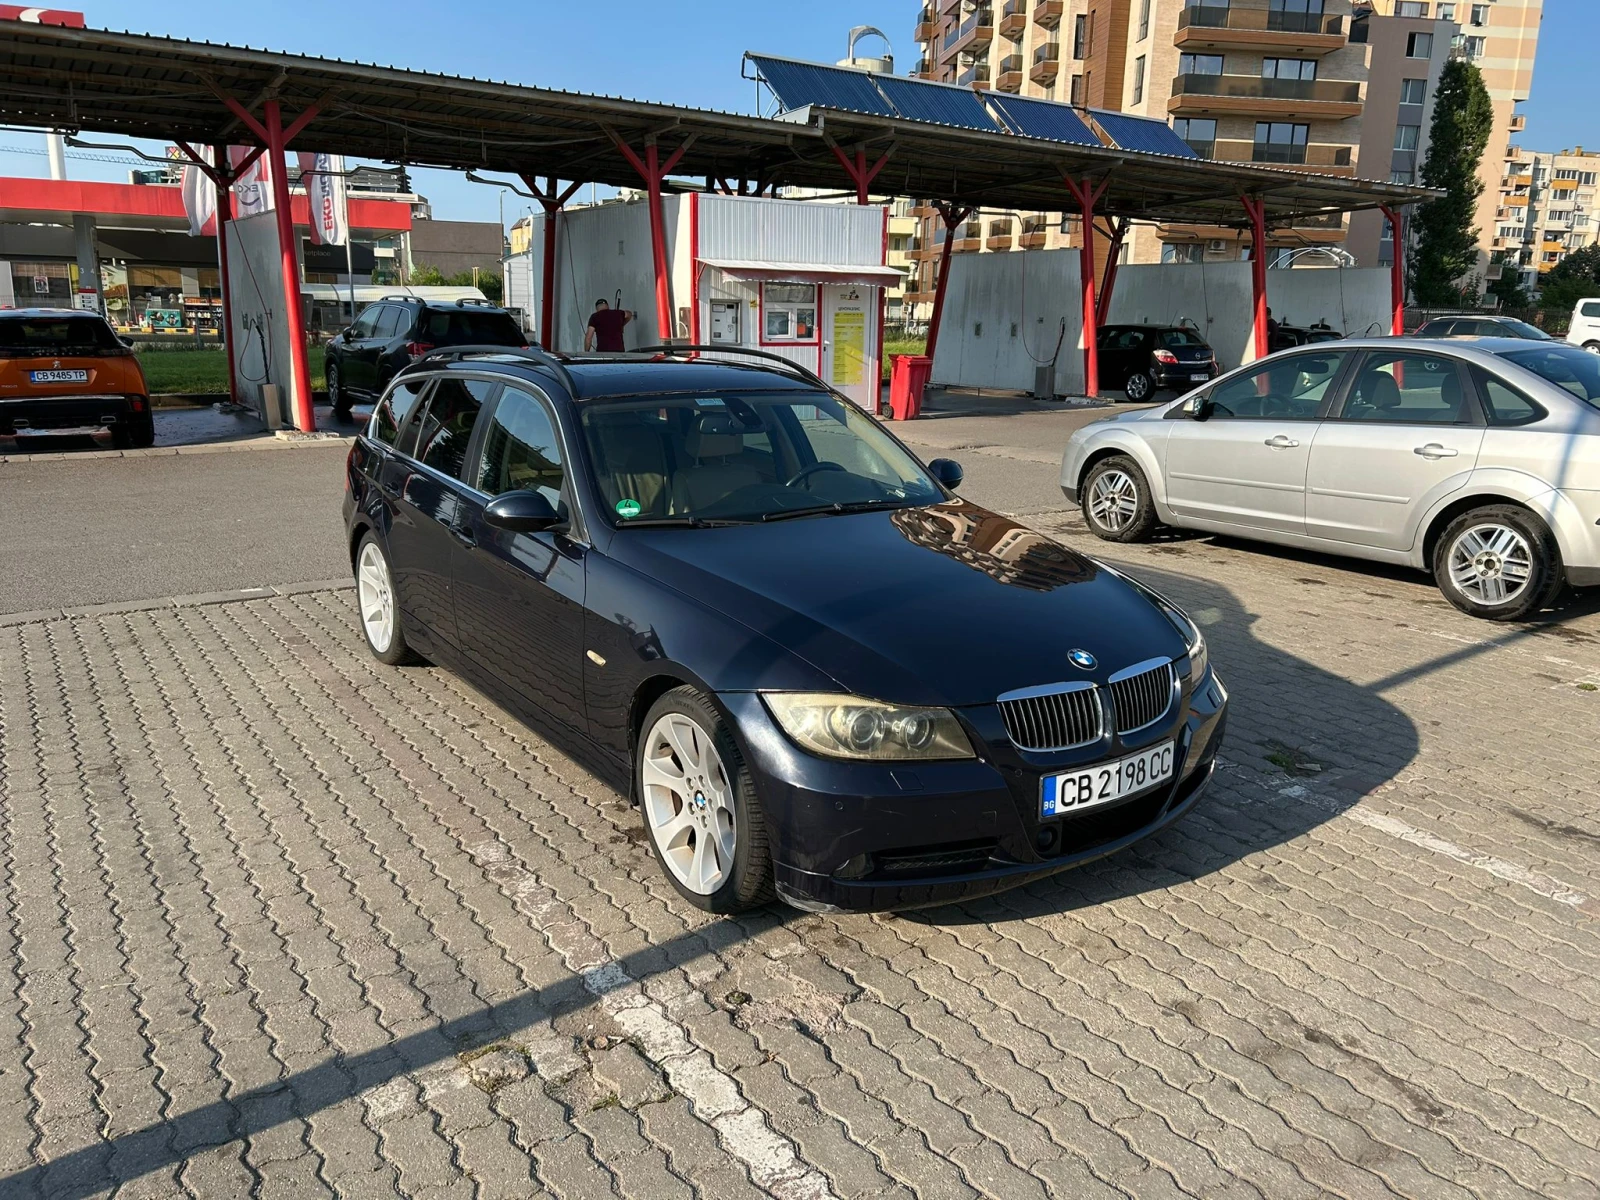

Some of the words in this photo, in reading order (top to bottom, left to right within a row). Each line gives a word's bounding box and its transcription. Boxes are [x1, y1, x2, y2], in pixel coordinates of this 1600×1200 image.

[36, 372, 49, 380] CB
[51, 371, 72, 380] 9485
[74, 371, 85, 380] TP
[1060, 774, 1092, 807] CB
[1098, 758, 1146, 799] 2198
[1149, 747, 1171, 780] CC
[1043, 800, 1055, 810] BG
